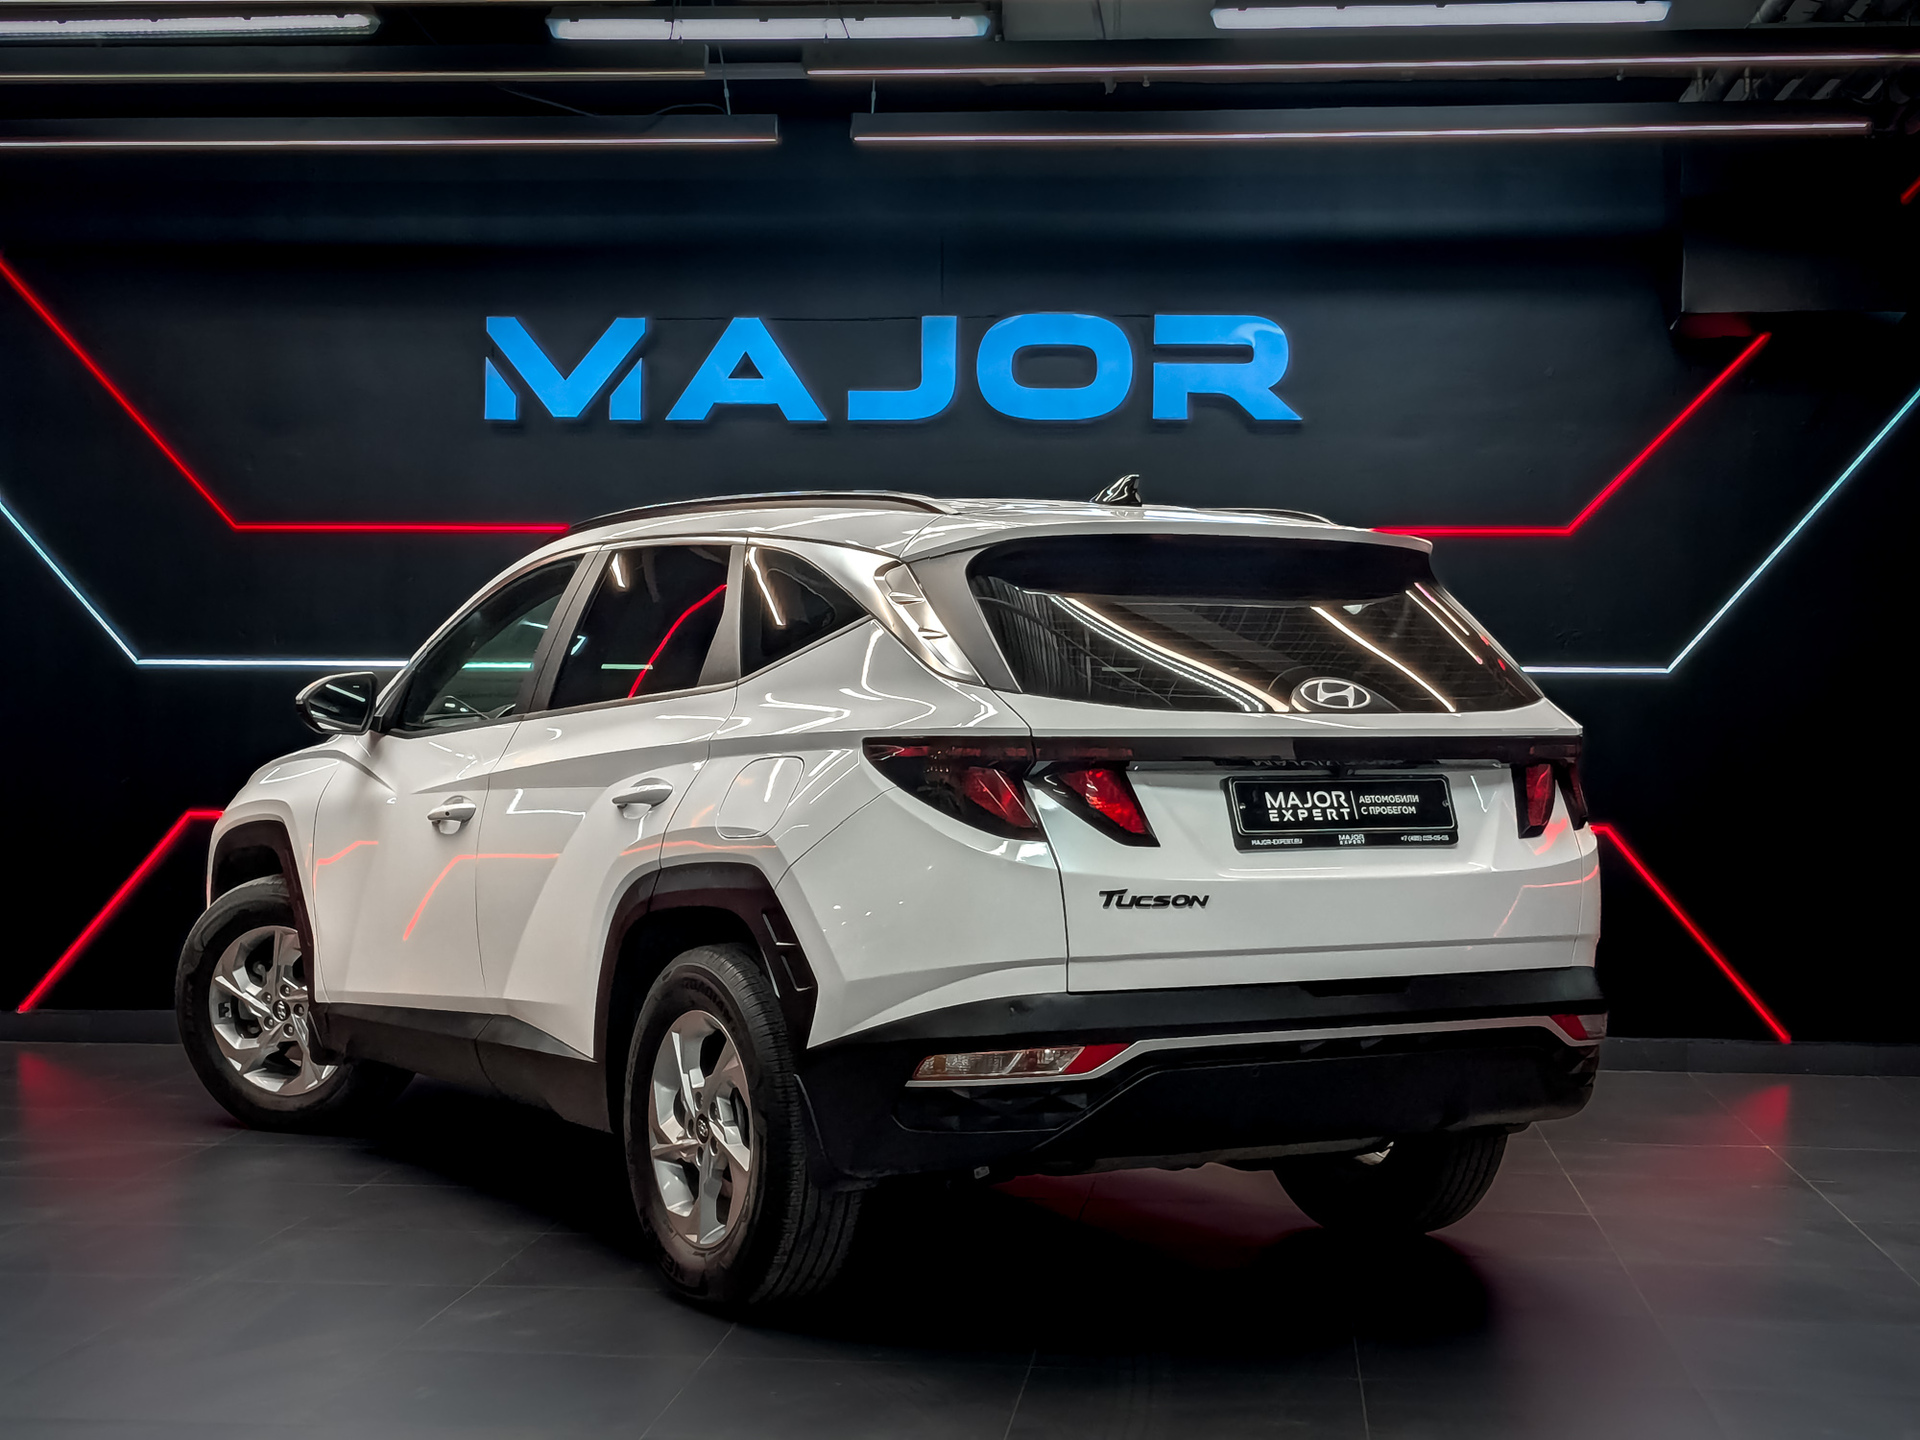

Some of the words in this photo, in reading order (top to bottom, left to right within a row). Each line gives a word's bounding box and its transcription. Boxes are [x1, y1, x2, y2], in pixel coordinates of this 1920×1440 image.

[484, 312, 1303, 422] MAJOR
[1264, 790, 1349, 808] MAJOR
[1359, 794, 1419, 804] АВТОМОБИЛИ
[1268, 808, 1350, 822] EXPERT
[1360, 806, 1369, 815] С
[1369, 805, 1417, 815] ПРОБЕГОМ
